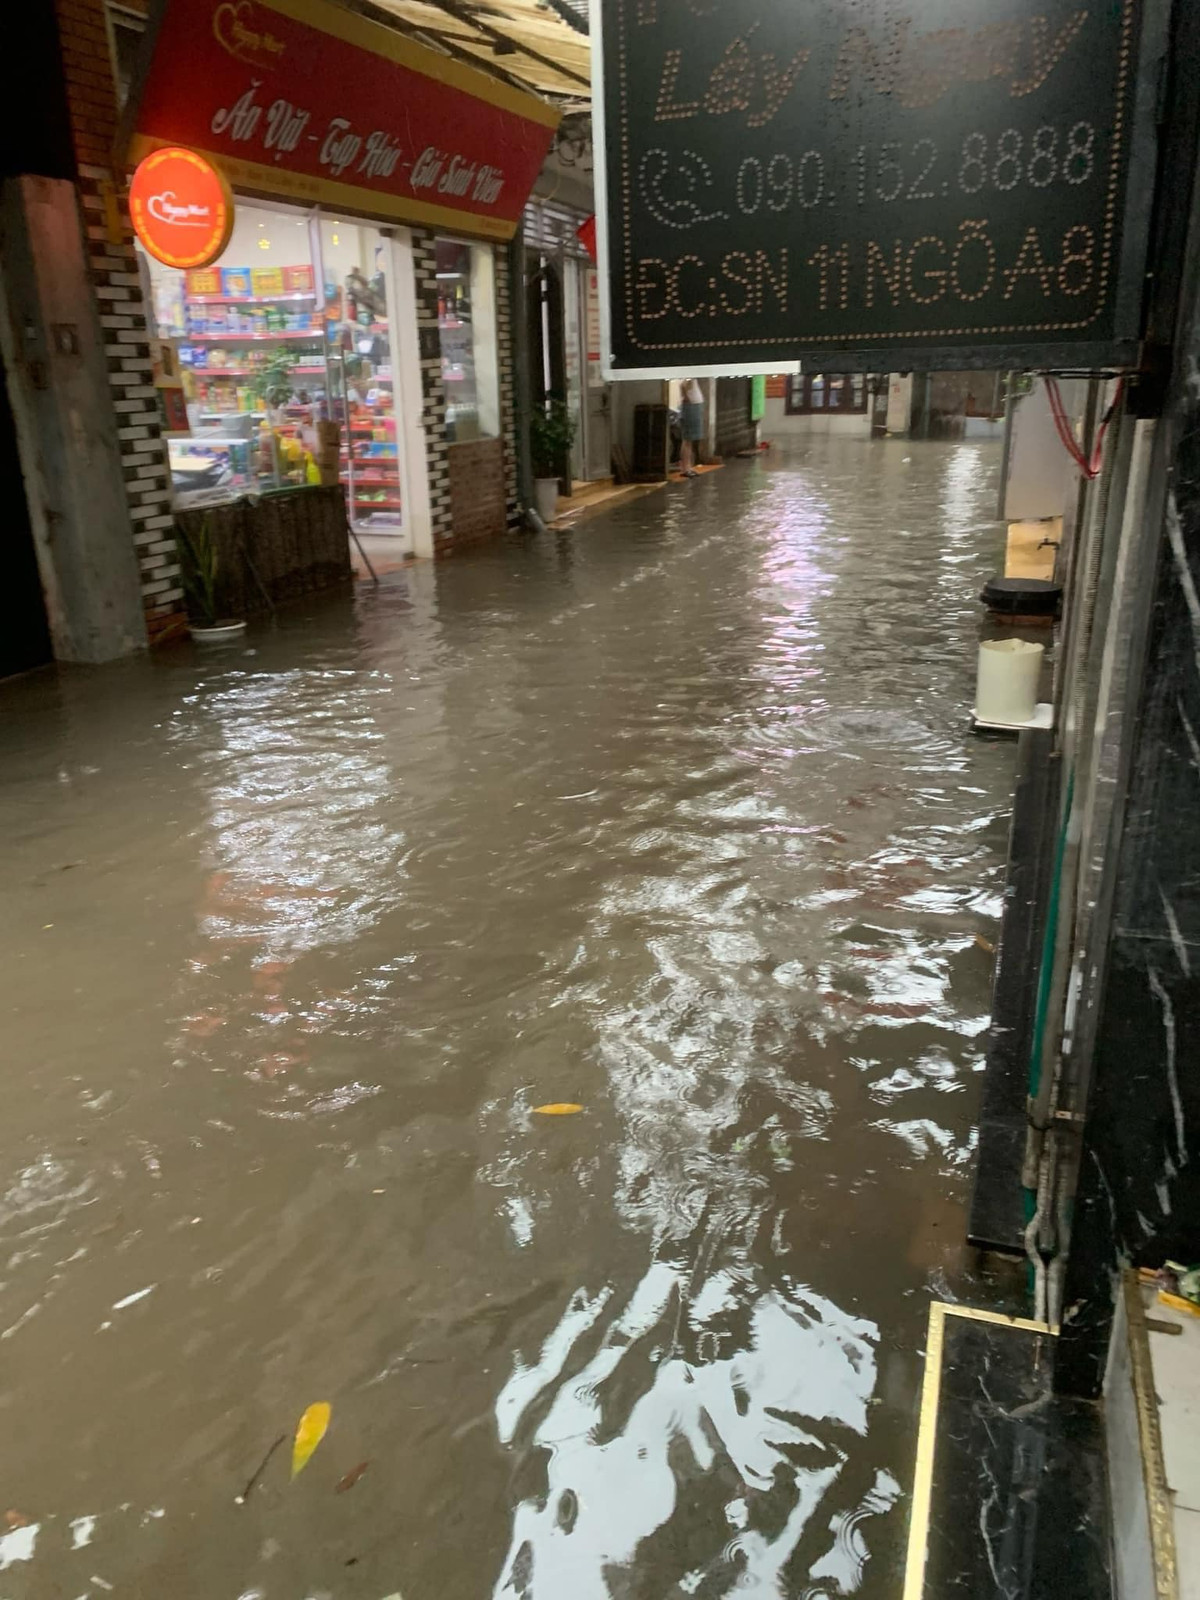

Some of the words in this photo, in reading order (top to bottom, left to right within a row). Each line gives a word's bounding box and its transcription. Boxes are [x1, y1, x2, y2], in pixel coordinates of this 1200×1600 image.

[211, 76, 264, 141] Ăn
[437, 154, 477, 197] Sinh
[865, 218, 997, 310] NGÕ
[1002, 224, 1096, 300] A8
